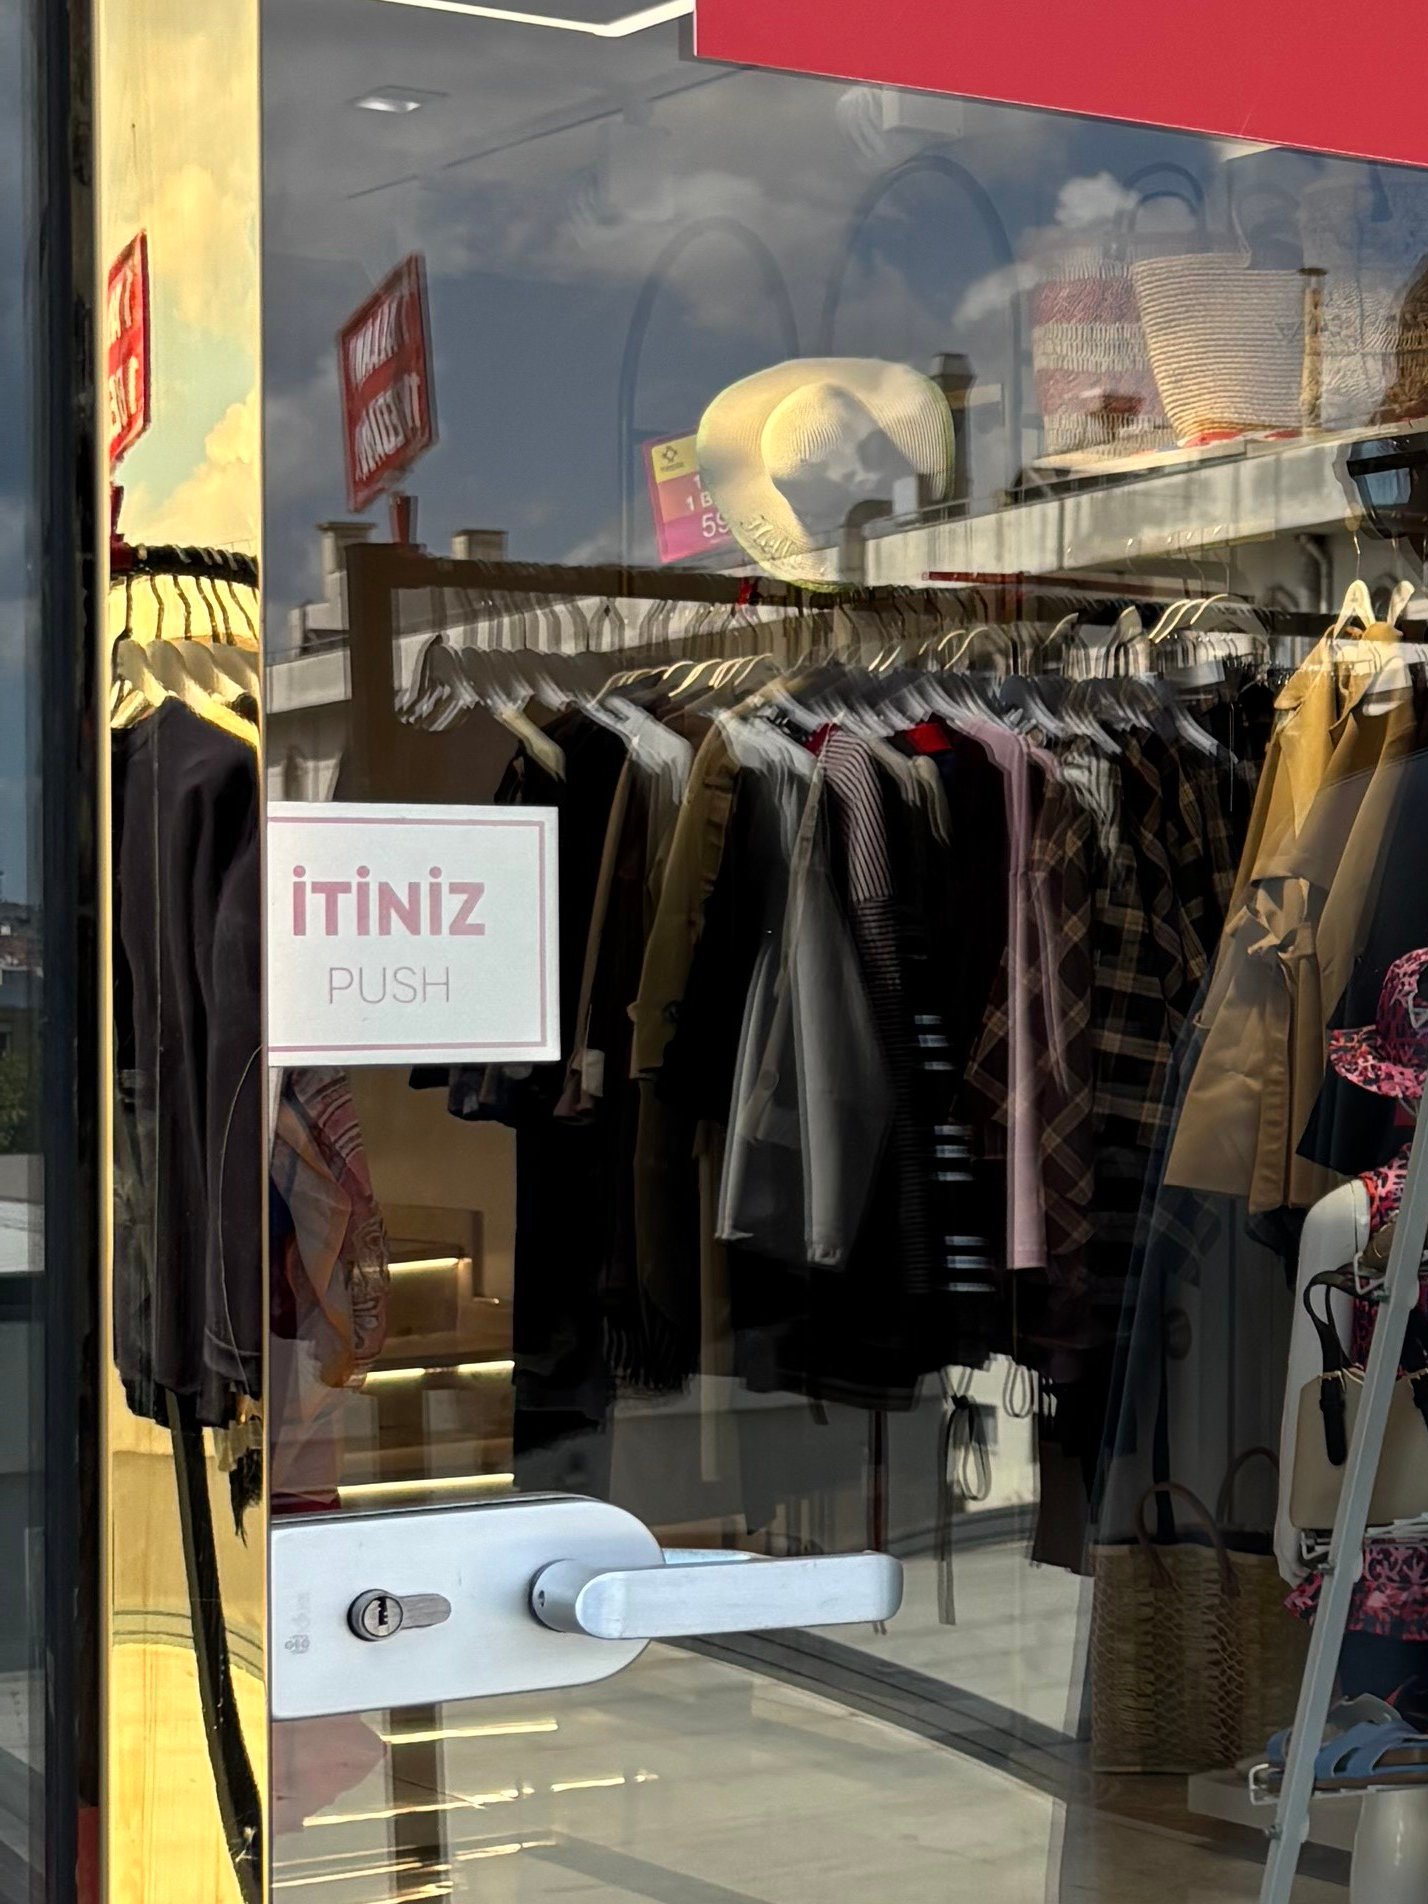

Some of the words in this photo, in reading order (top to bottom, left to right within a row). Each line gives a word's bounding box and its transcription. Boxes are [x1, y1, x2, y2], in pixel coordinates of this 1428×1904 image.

[685, 495, 695, 512] 1
[293, 864, 487, 936] İTİNİZ
[329, 966, 450, 1004] PUSH
